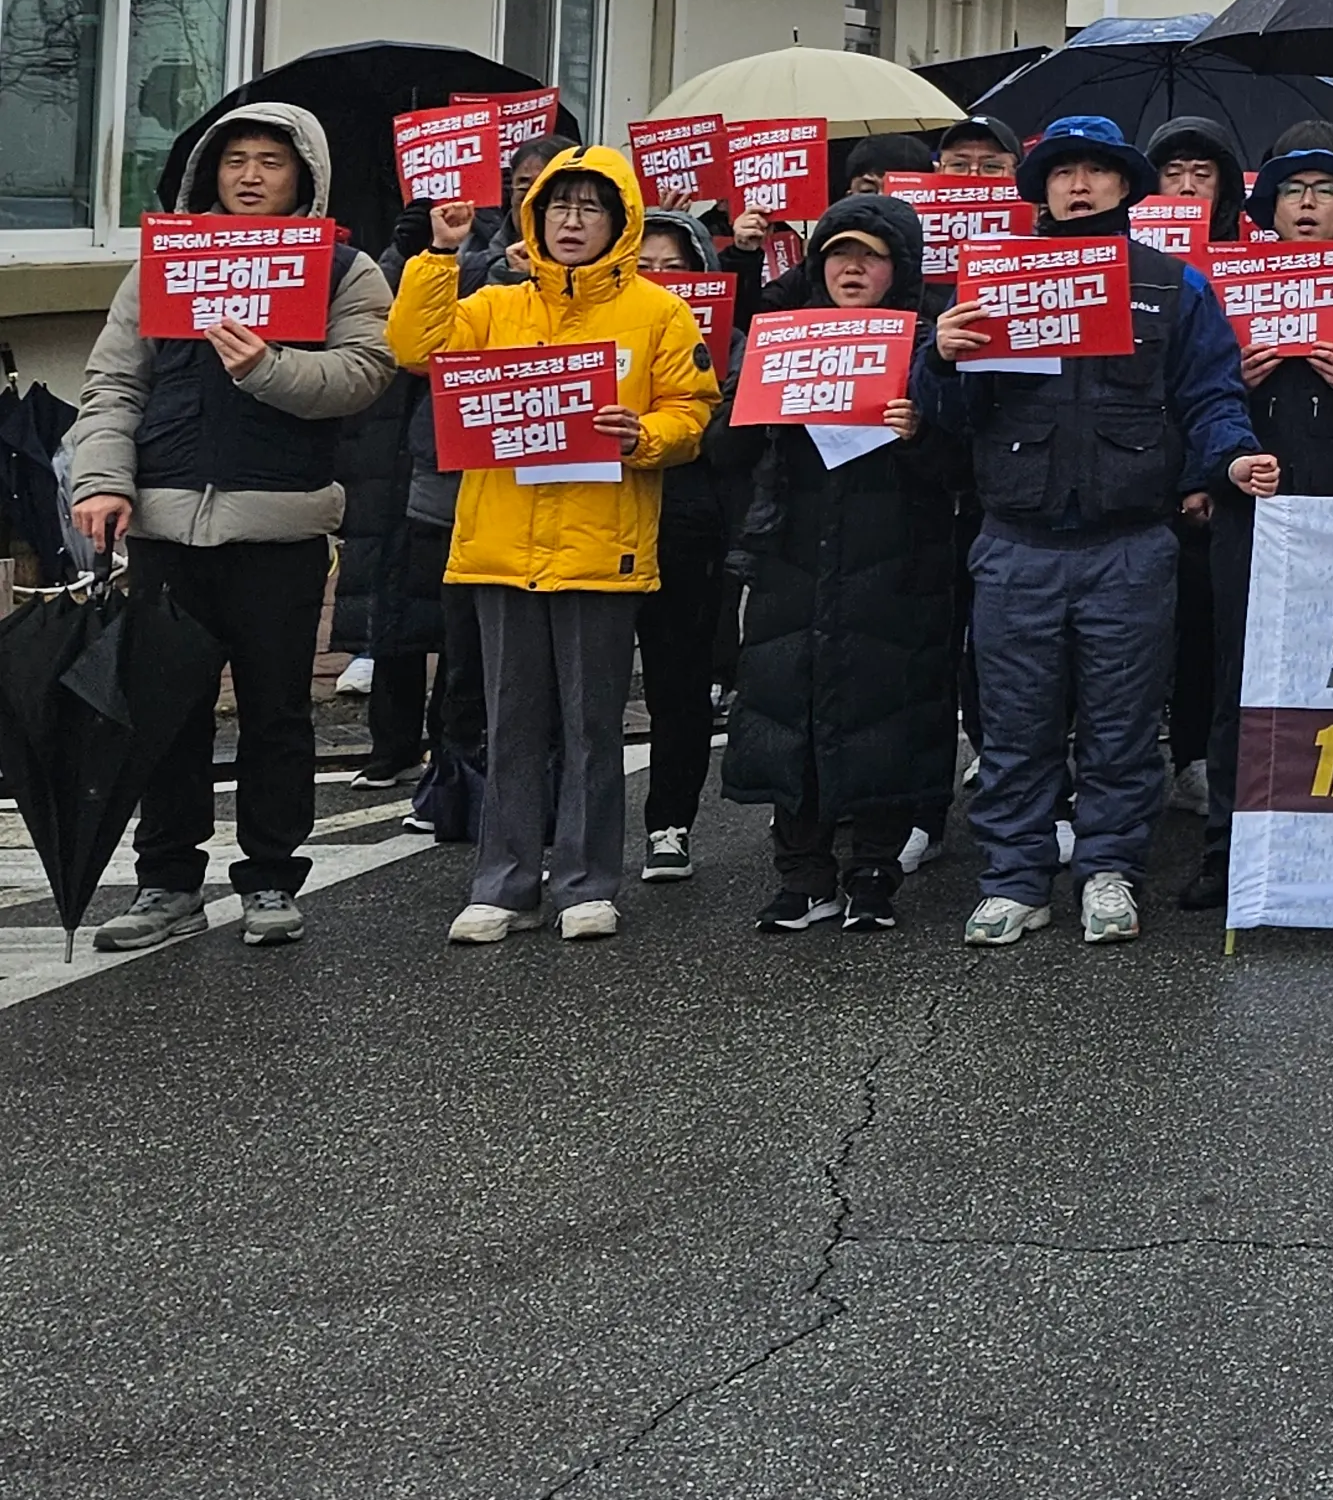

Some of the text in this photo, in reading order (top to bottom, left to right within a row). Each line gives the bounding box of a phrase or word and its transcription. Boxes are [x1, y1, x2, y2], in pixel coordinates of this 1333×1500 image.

[402, 135, 483, 180] 집단해고
[641, 141, 714, 178] 집단해고
[733, 149, 809, 188] 집단해고
[937, 187, 989, 203] 구조조정
[991, 186, 1022, 200] 중단
[1174, 206, 1201, 219] 중단!
[153, 227, 322, 251] 한국GM 구조조정 중단!
[918, 210, 1011, 242] 단해고
[164, 255, 305, 294] 집단해고
[968, 257, 1019, 277] 한국GM
[1021, 250, 1079, 270] 구조조정
[1081, 246, 1117, 264] 중단!
[1212, 259, 1264, 277] 한국GM
[1267, 252, 1321, 271] 구조조정
[695, 281, 726, 296] 중단!
[977, 274, 1107, 318] 집단해고
[192, 294, 271, 330] 철회!
[1250, 313, 1317, 346] 철회!
[756, 319, 904, 347] 한국GM 구조조정 중단!
[1007, 314, 1081, 350] 철회!
[443, 367, 501, 388] 한국GM
[503, 357, 565, 379] 구조조정
[567, 351, 605, 370] 중단!
[761, 344, 887, 384] 집단해고
[459, 381, 594, 428] 집단해고
[781, 381, 854, 415] 철회!
[491, 421, 567, 460] 철회!
